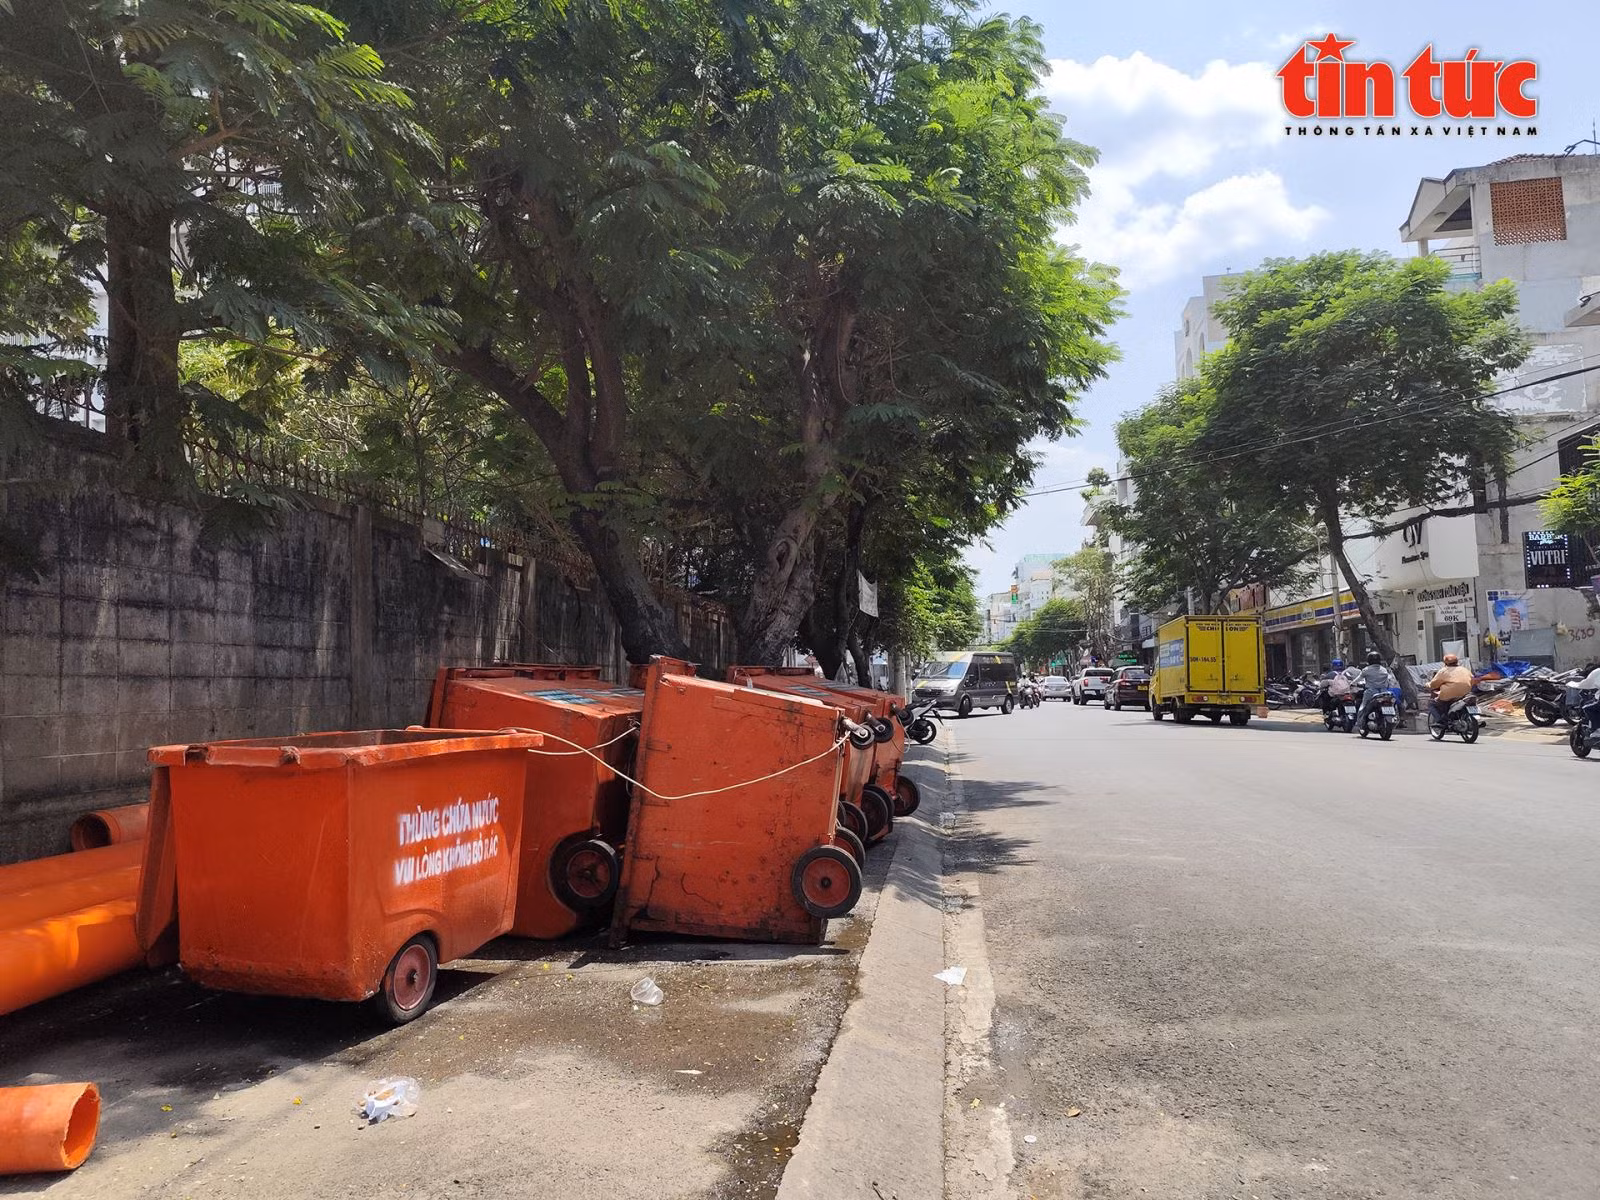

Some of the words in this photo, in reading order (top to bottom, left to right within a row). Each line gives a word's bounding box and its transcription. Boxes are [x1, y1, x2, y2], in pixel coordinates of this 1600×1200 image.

[399, 806, 440, 846] THÙNG
[442, 797, 470, 835] CHỨA
[472, 792, 500, 827] NƯỚC
[395, 858, 415, 885] VUI
[416, 847, 442, 879] LÒNG
[442, 839, 471, 871] KHÔNG
[484, 830, 498, 860] RÁC
